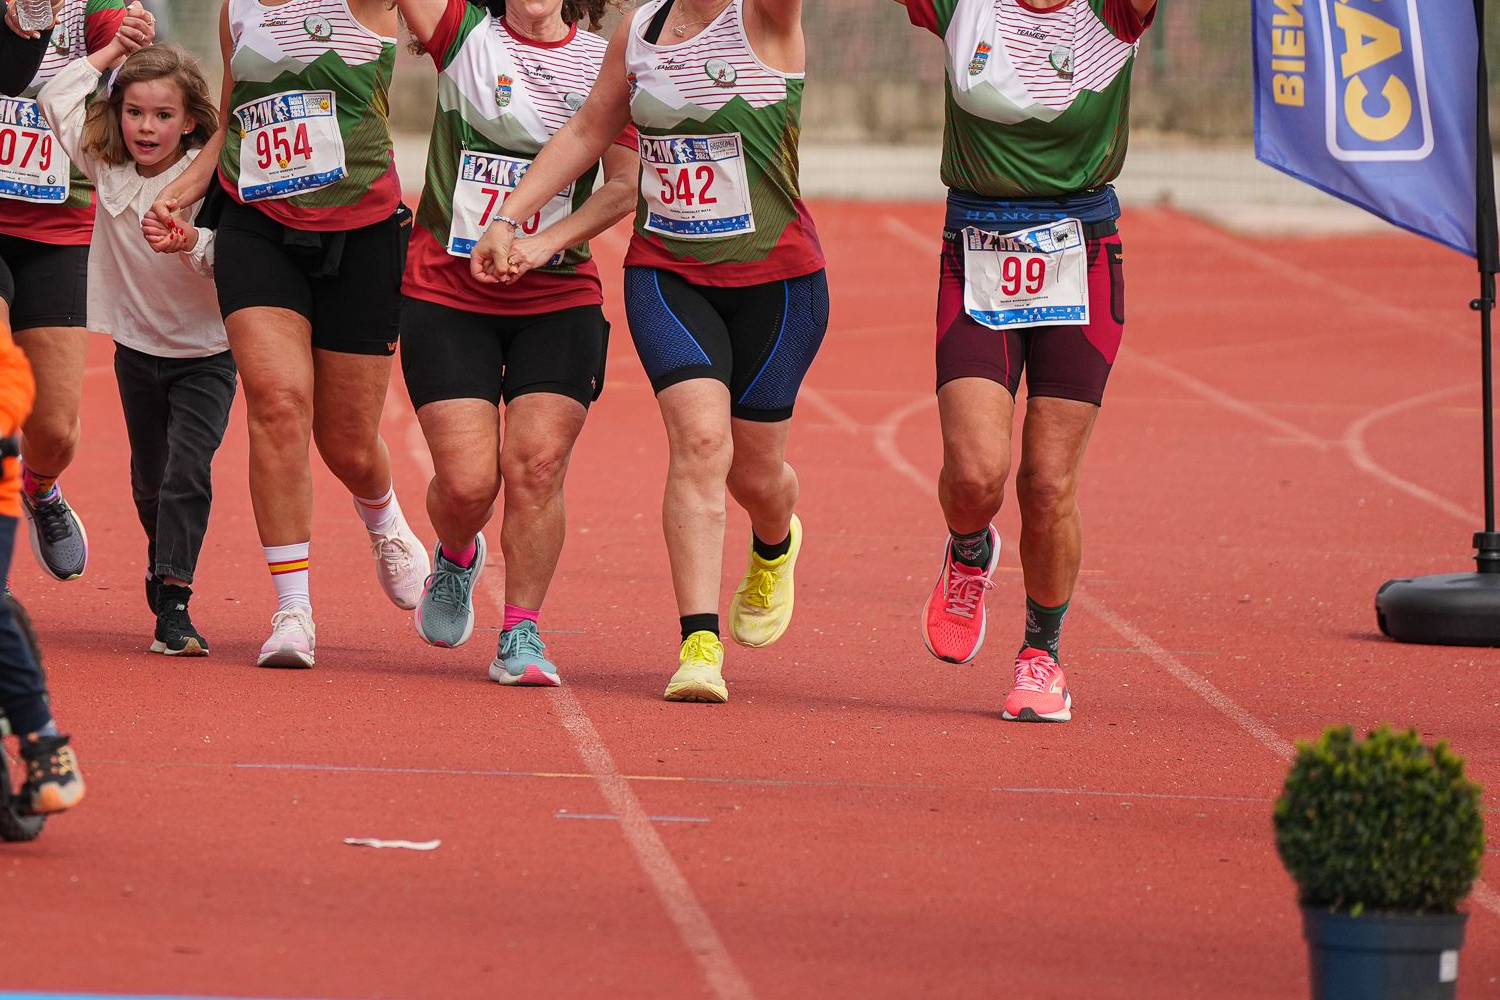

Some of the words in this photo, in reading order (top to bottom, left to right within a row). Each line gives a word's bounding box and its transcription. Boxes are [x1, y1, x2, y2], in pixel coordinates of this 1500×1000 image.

[249, 101, 274, 130] 21K
[256, 122, 313, 169] 954
[643, 140, 675, 162] 21K
[474, 157, 512, 185] 21K
[656, 166, 717, 206] 542
[1001, 256, 1046, 296] 99
